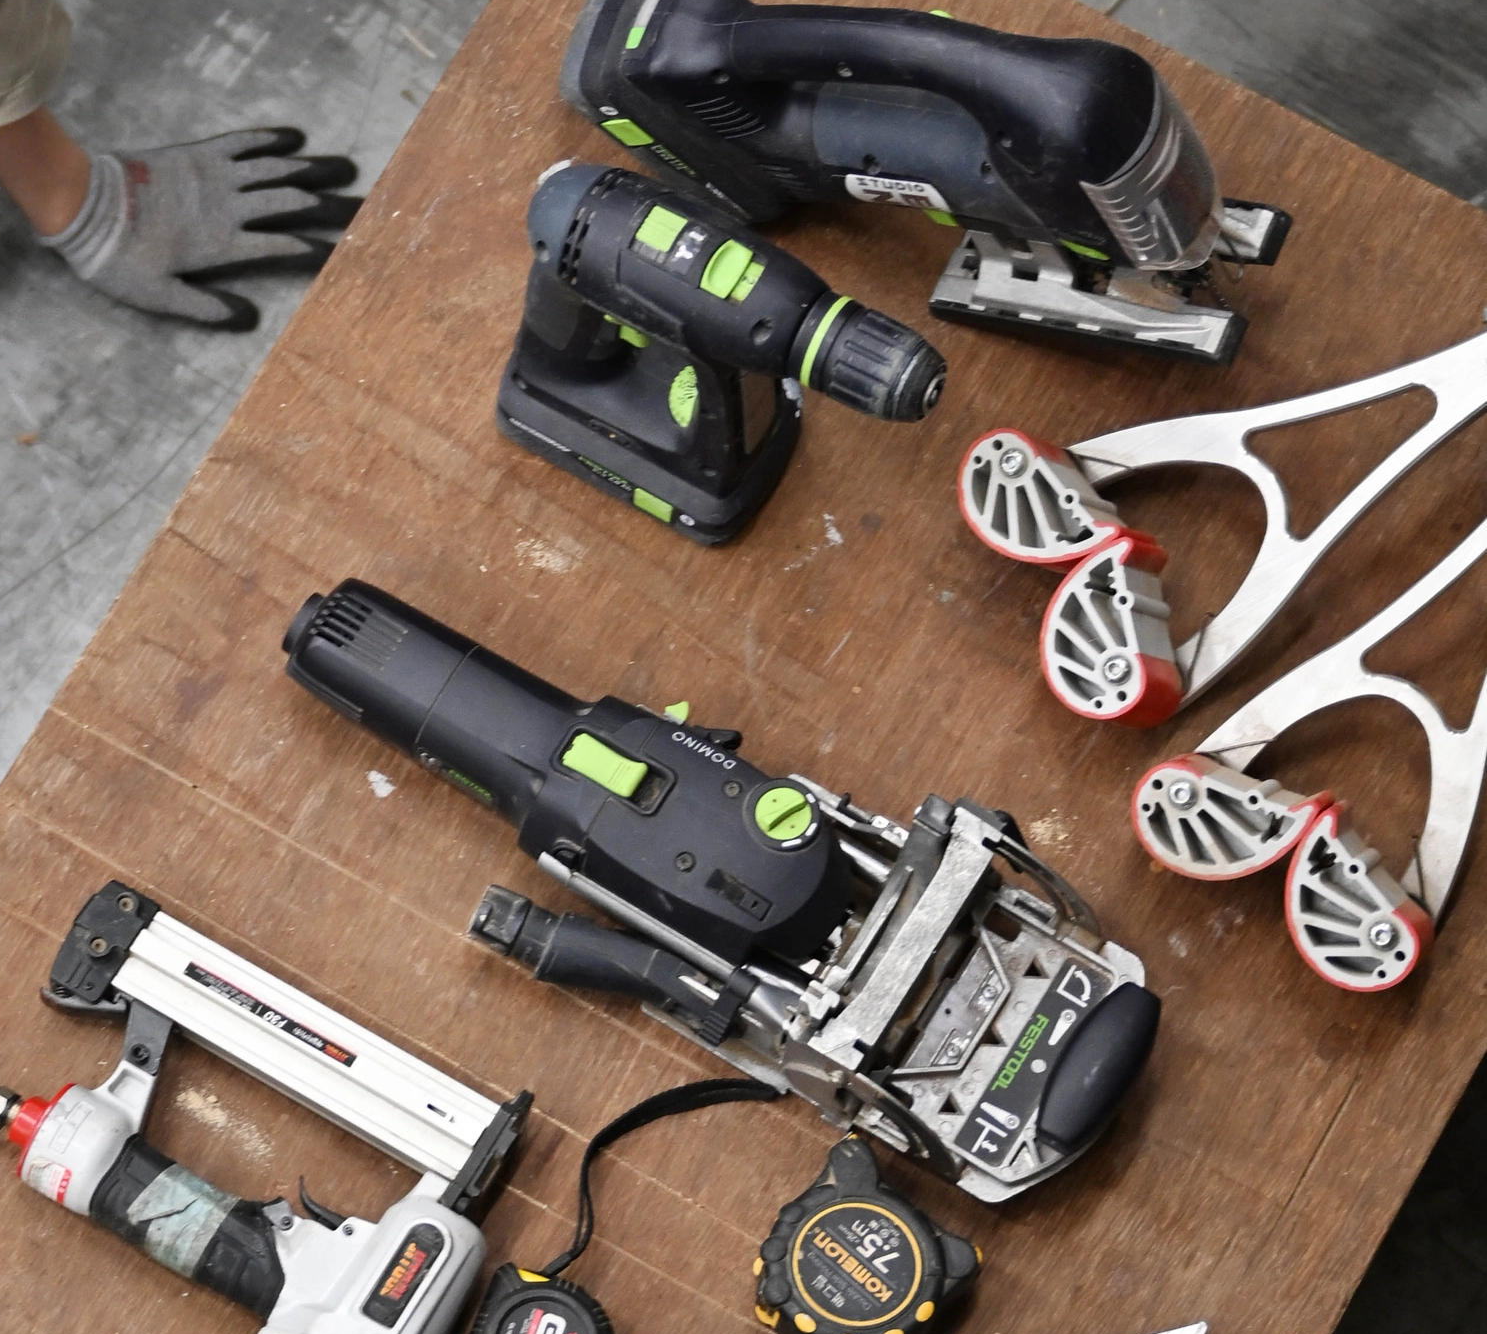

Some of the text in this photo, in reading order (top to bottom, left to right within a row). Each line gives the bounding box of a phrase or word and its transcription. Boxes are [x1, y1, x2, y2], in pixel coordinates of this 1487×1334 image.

[854, 173, 926, 196] STUDIO
[669, 727, 737, 772] DOMINO
[990, 1009, 1050, 1098] FESTOOL
[812, 1230, 893, 1303] KOMELON
